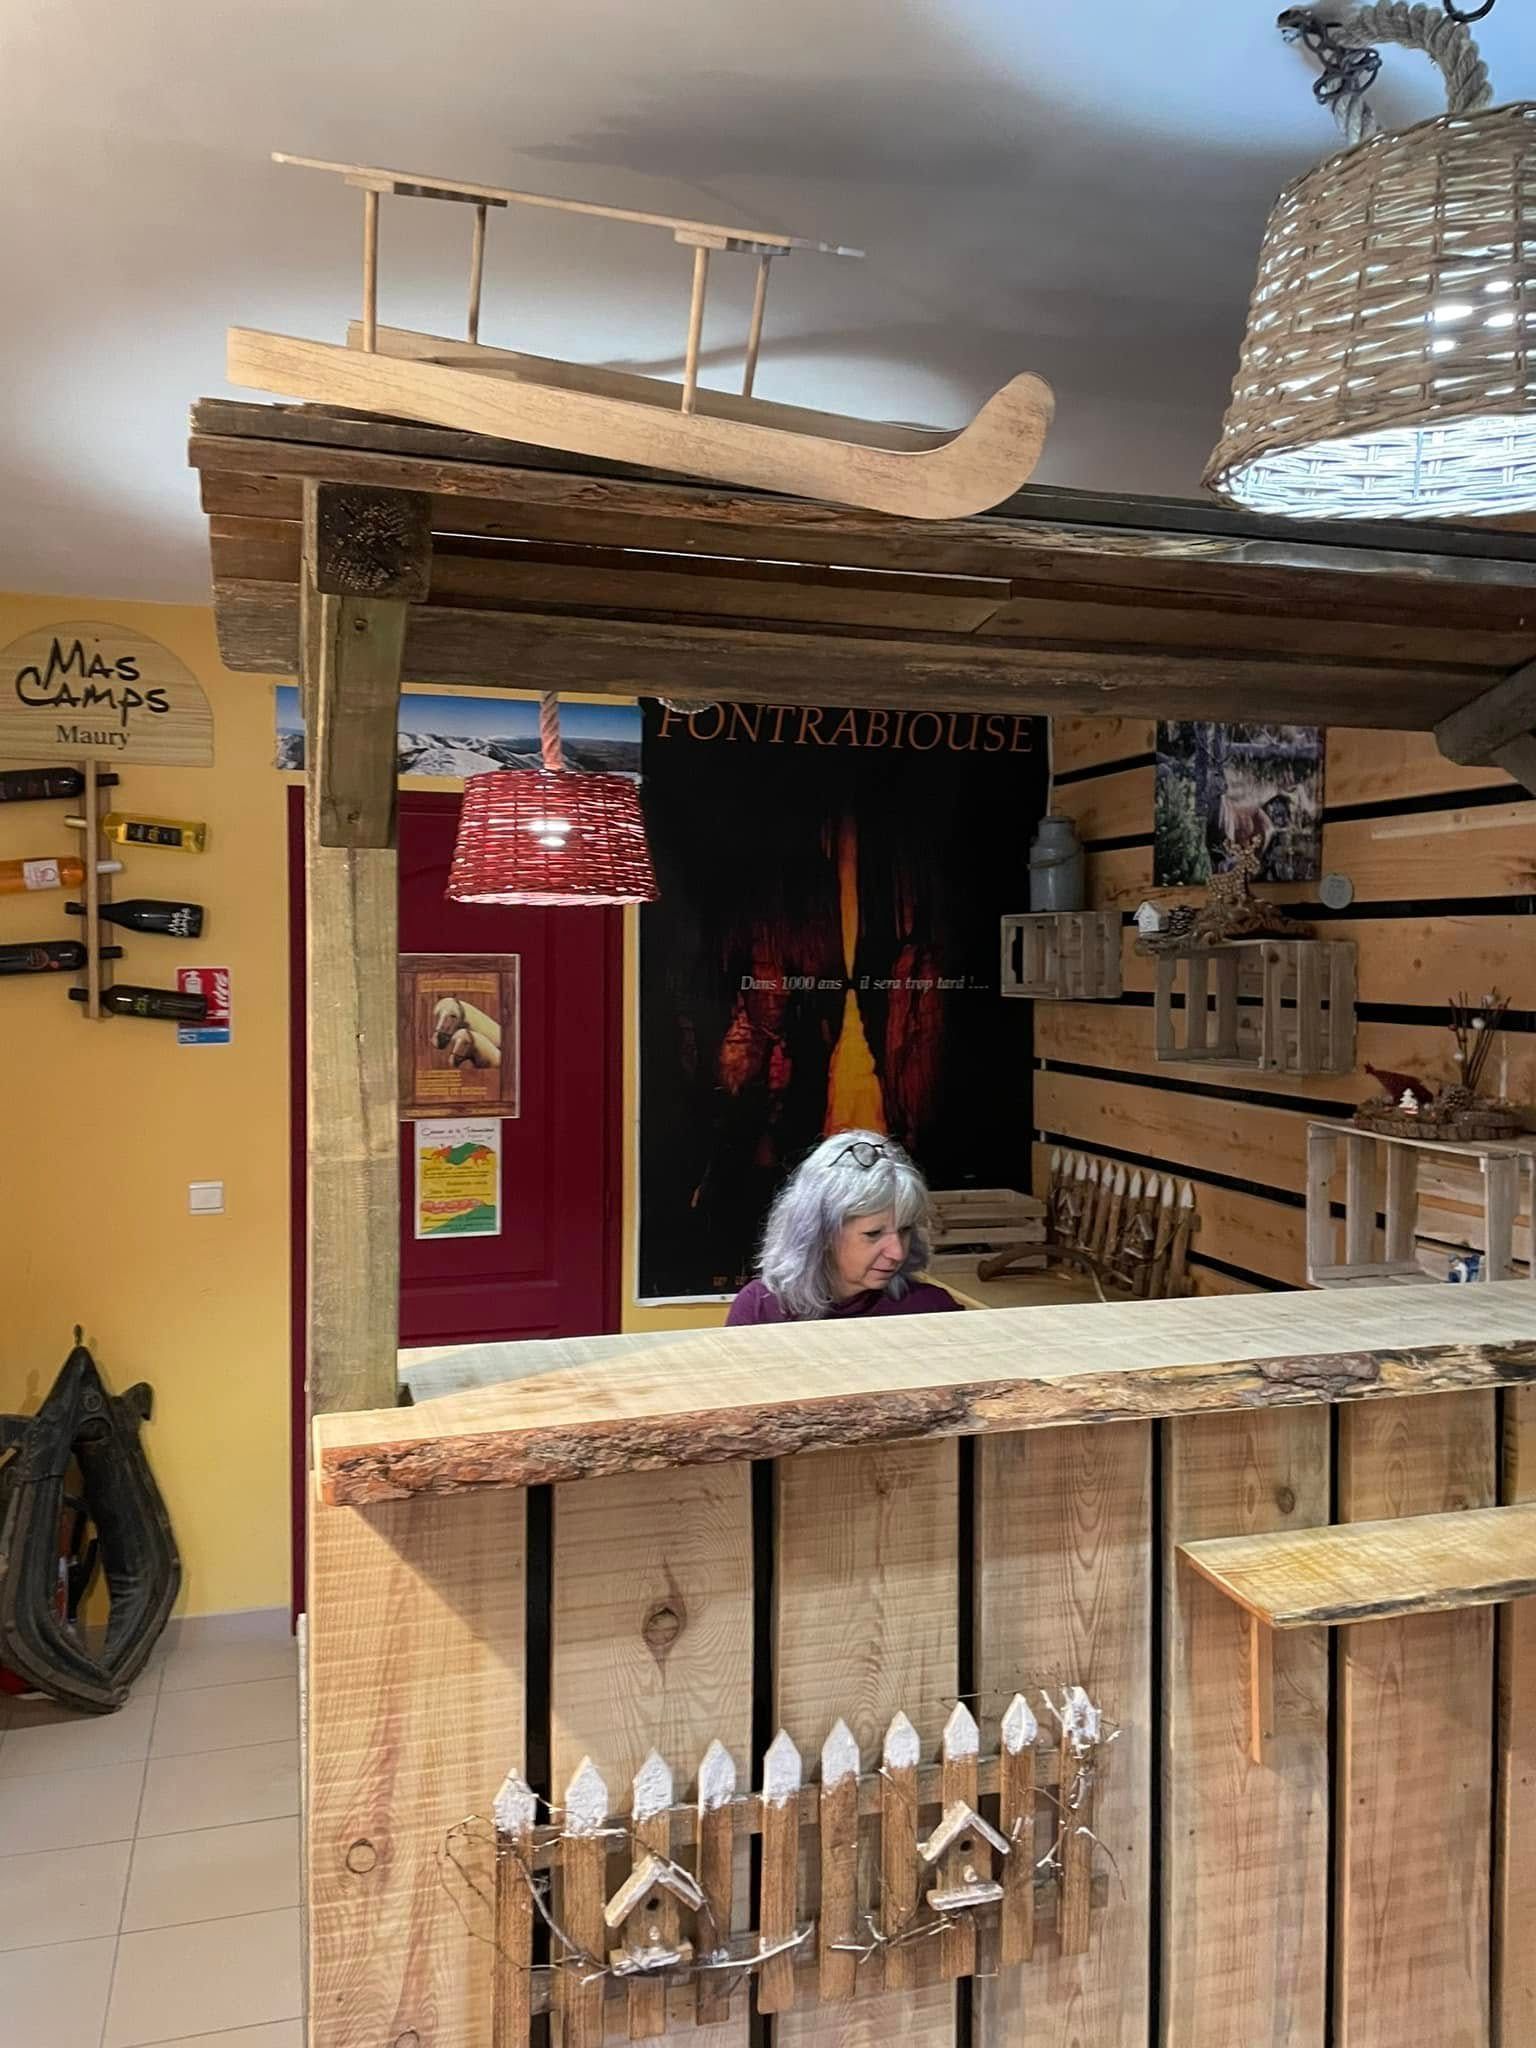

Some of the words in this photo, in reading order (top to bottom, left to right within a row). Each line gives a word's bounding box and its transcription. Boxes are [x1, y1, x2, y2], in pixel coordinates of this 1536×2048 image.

[56, 724, 130, 750] Maury
[657, 702, 1033, 752] FONTRABIOUSE
[740, 975, 777, 990] Dans
[781, 976, 816, 990] 1000
[817, 978, 842, 990] ans
[859, 975, 870, 990] il
[873, 979, 901, 990] sera
[905, 977, 934, 993] trop
[936, 975, 965, 990] tard
